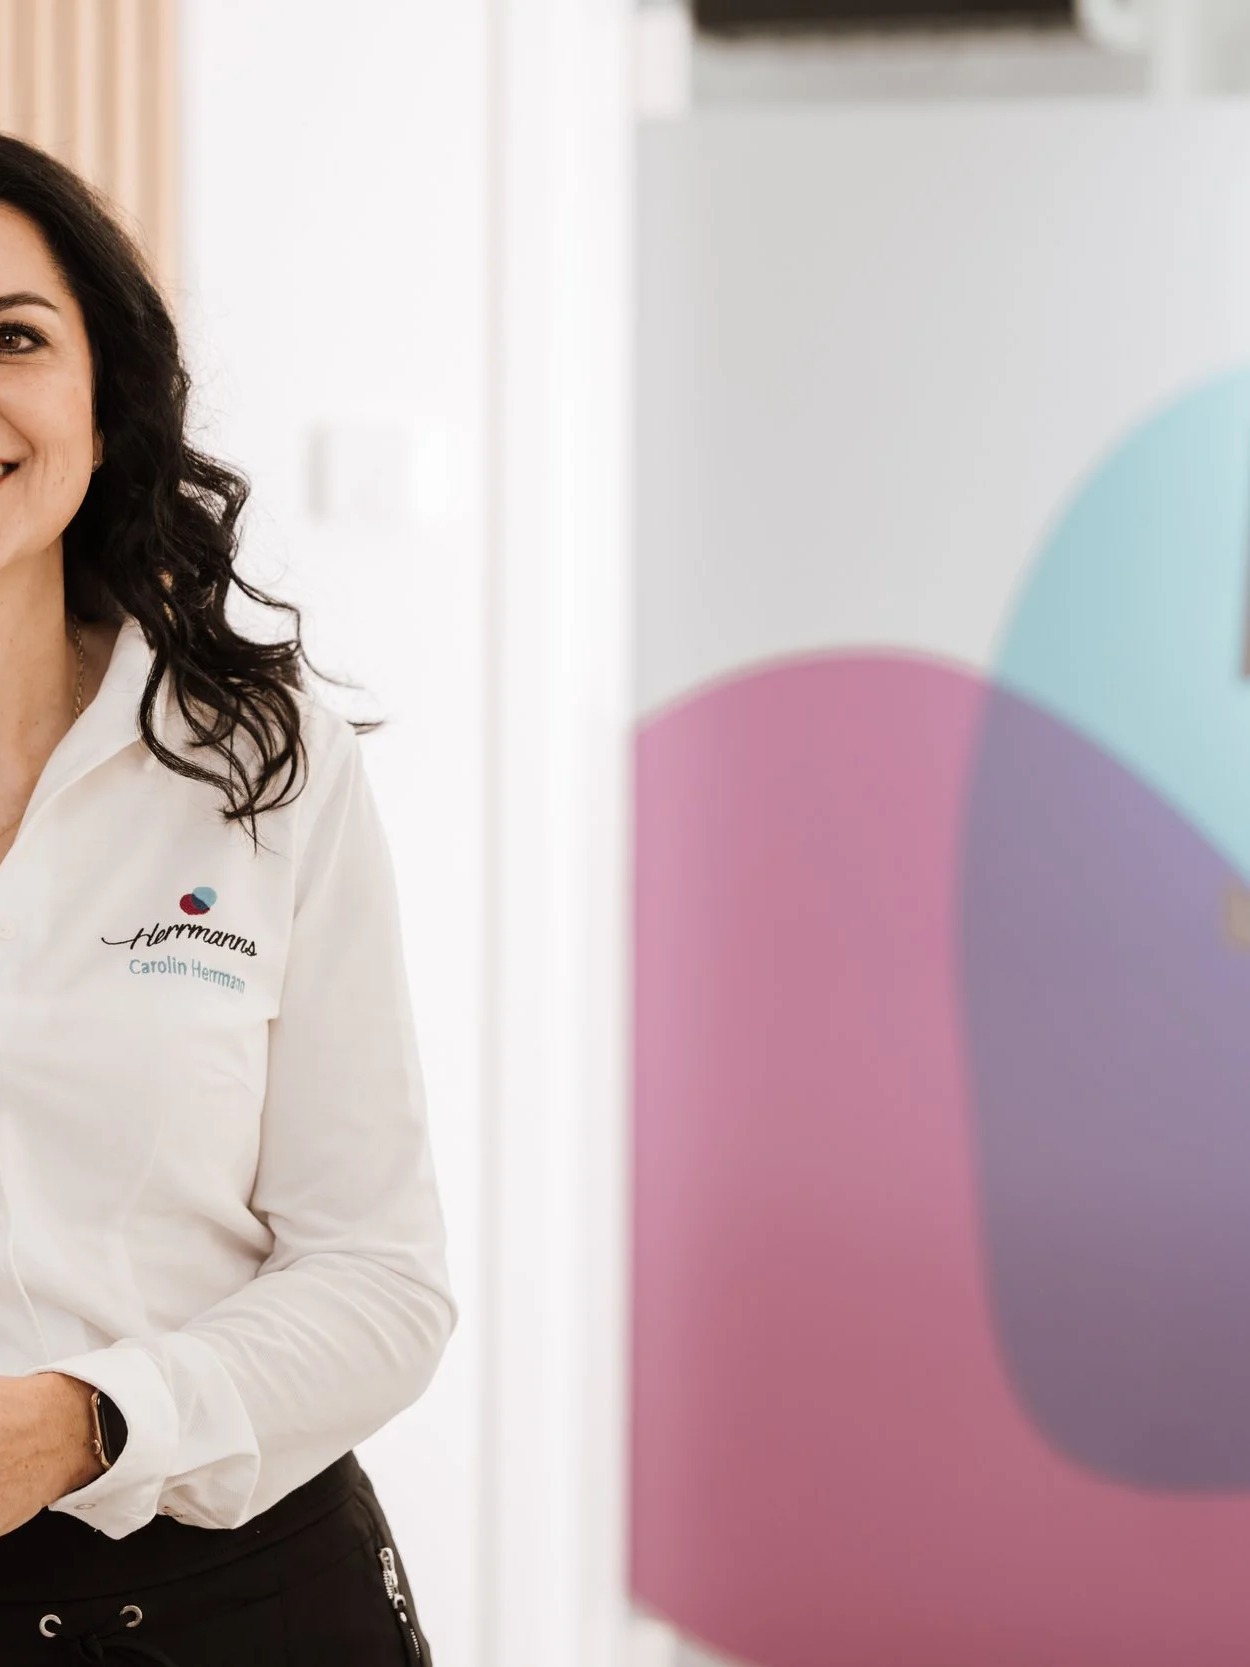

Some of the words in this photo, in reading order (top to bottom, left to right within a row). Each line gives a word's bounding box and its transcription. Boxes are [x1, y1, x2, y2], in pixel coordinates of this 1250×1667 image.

[101, 922, 257, 957] Herrmanns
[129, 955, 188, 975] Carolin
[191, 958, 246, 994] Herrmann
